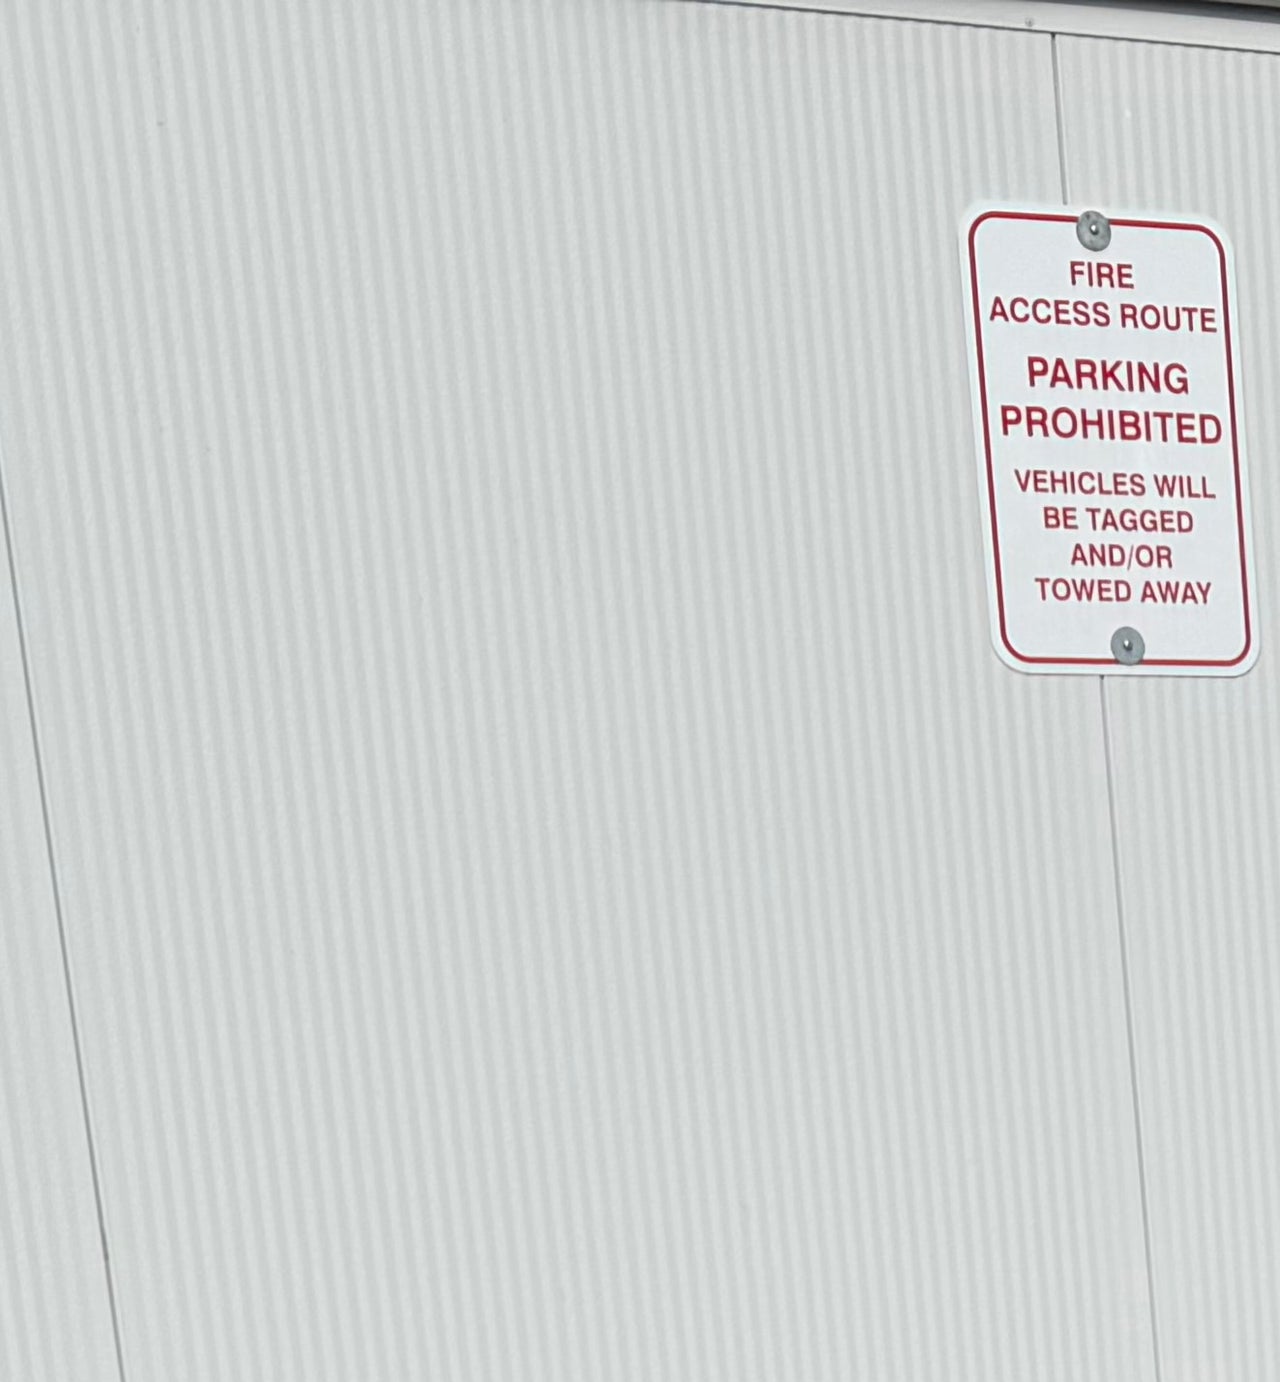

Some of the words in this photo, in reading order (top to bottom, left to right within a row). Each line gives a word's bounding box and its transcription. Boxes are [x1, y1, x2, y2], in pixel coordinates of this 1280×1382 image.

[1069, 260, 1135, 290] FIRE
[989, 296, 1112, 328] ACCESS
[1120, 303, 1217, 334] ROUTE
[1027, 355, 1189, 395] PARKING
[1000, 404, 1223, 446] PROHIBITED
[1014, 469, 1146, 497] VEHICLES
[1153, 474, 1216, 500] WILL
[1043, 505, 1078, 531] BE
[1086, 507, 1194, 534] TAGGED
[1070, 543, 1173, 570] AND/OR
[1035, 577, 1132, 603] TOWED
[1140, 581, 1211, 605] AWAY
